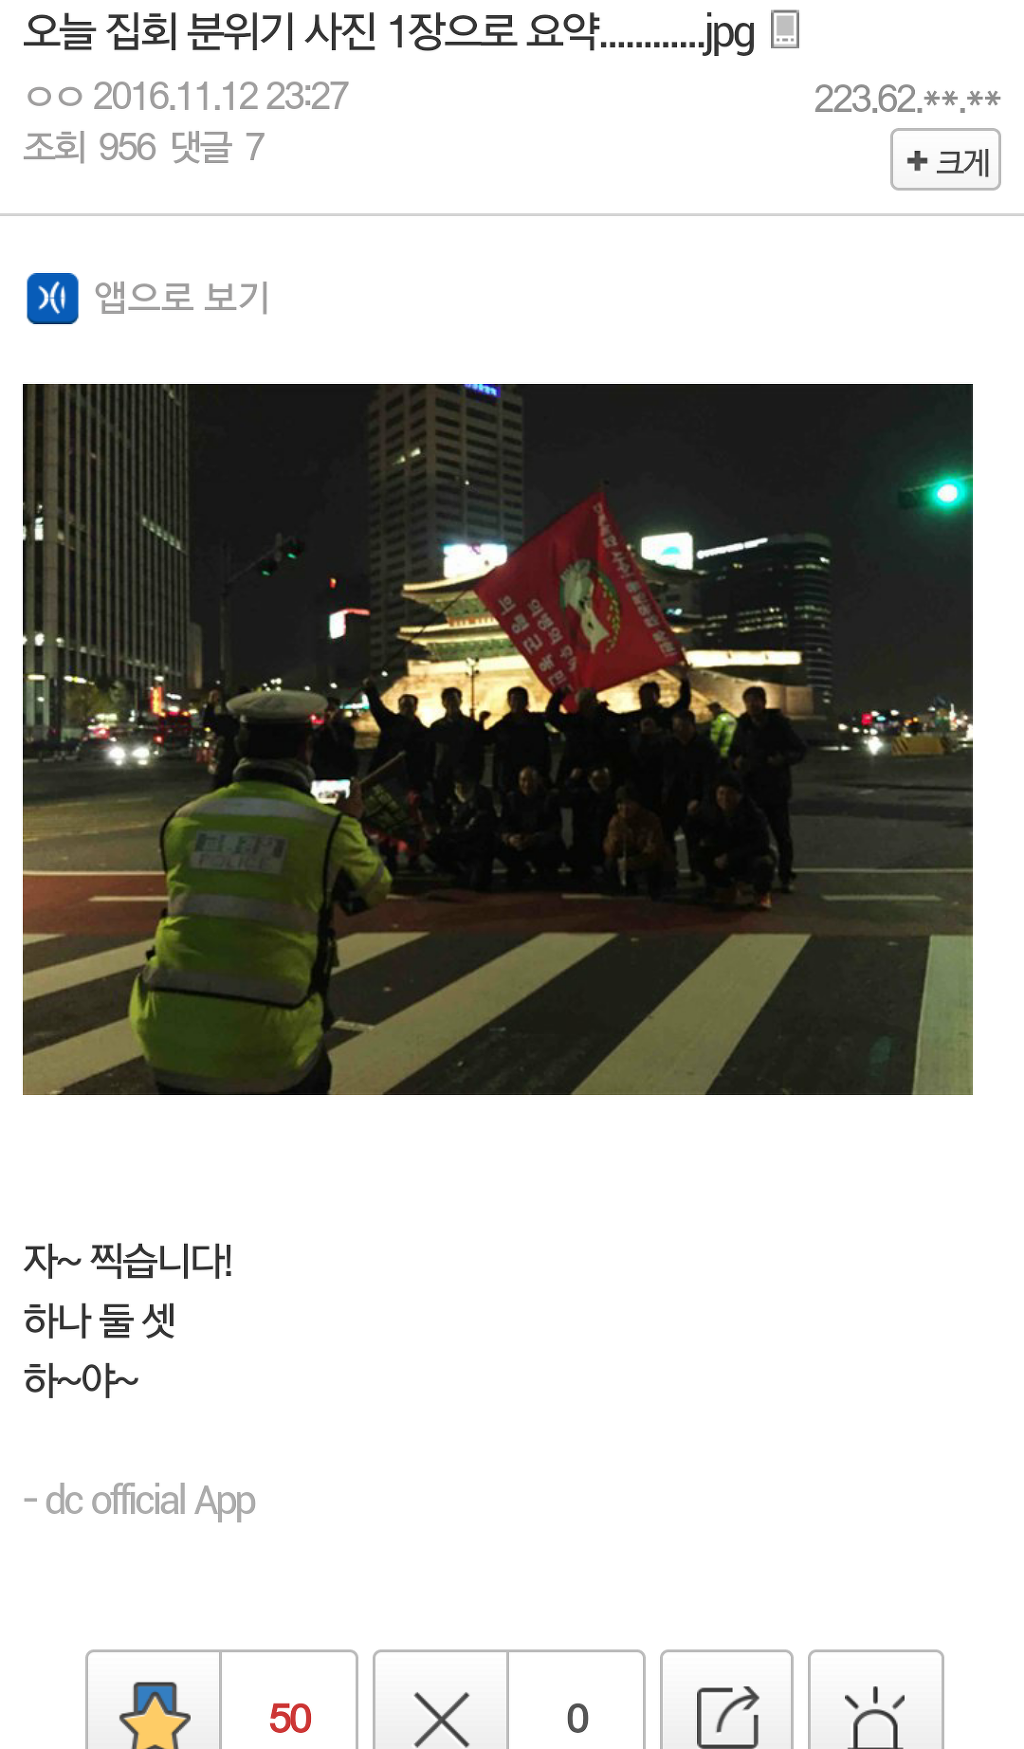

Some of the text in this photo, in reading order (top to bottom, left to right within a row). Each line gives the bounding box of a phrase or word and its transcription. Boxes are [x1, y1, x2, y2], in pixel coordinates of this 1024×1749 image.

[23, 12, 97, 51] 오늘
[106, 12, 177, 51] 집회
[187, 12, 294, 51] 분위기
[304, 12, 376, 51] 사진
[390, 12, 519, 51] 1장으로
[93, 81, 259, 111] 2016.11.12
[266, 81, 350, 110] 23:27
[23, 131, 266, 164] 조회 956 댓글 7
[936, 148, 989, 178] 크게
[95, 281, 268, 315] 앱으로 보기
[23, 1243, 233, 1280] 자~ 찍습니다!
[24, 1303, 175, 1340] 하나 둘 셋
[24, 1363, 140, 1400] 하~야~
[46, 1483, 84, 1515] dc
[92, 1483, 186, 1515] official
[194, 1484, 256, 1524] App
[269, 1702, 312, 1734] 50
[566, 1702, 590, 1734] 0
